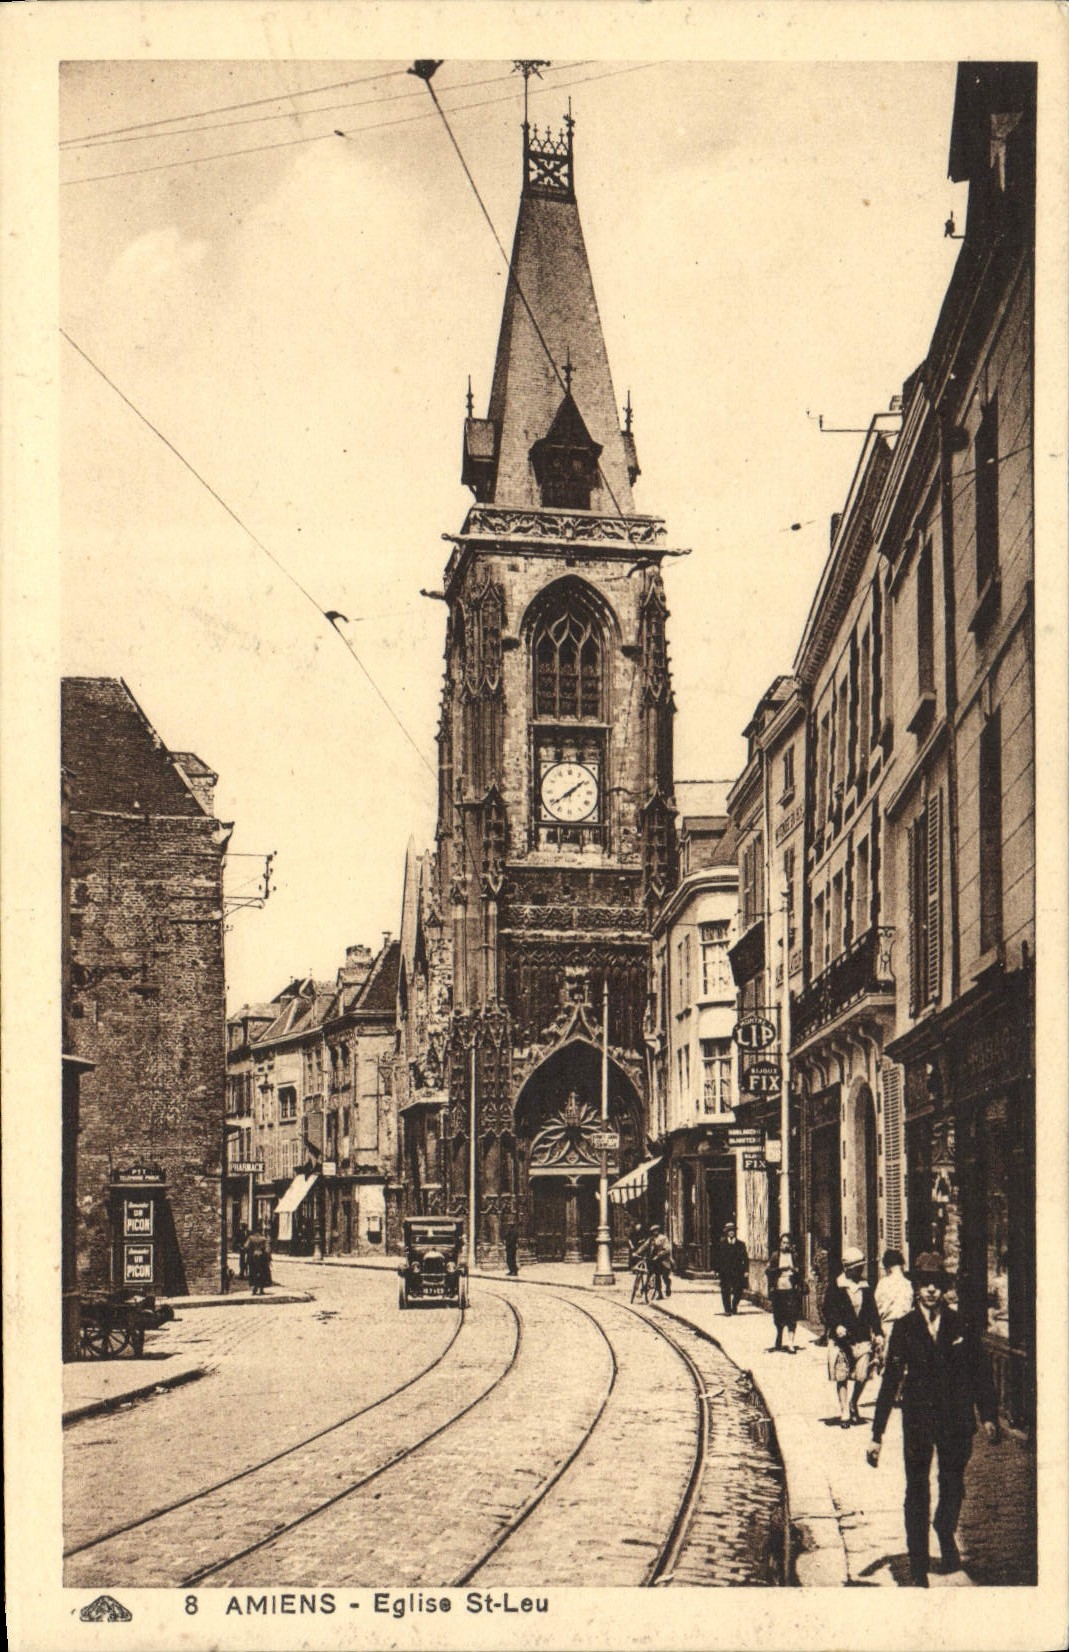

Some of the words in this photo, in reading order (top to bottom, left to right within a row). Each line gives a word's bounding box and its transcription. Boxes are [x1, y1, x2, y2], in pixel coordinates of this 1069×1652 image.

[736, 1024, 774, 1047] LIP
[750, 1067, 778, 1075] BIJOUX
[748, 1074, 781, 1091] FIX
[228, 1162, 263, 1172] PHARMACIE
[744, 1160, 766, 1168] FIX
[127, 1218, 150, 1232] PICON
[126, 1264, 150, 1278] PICON
